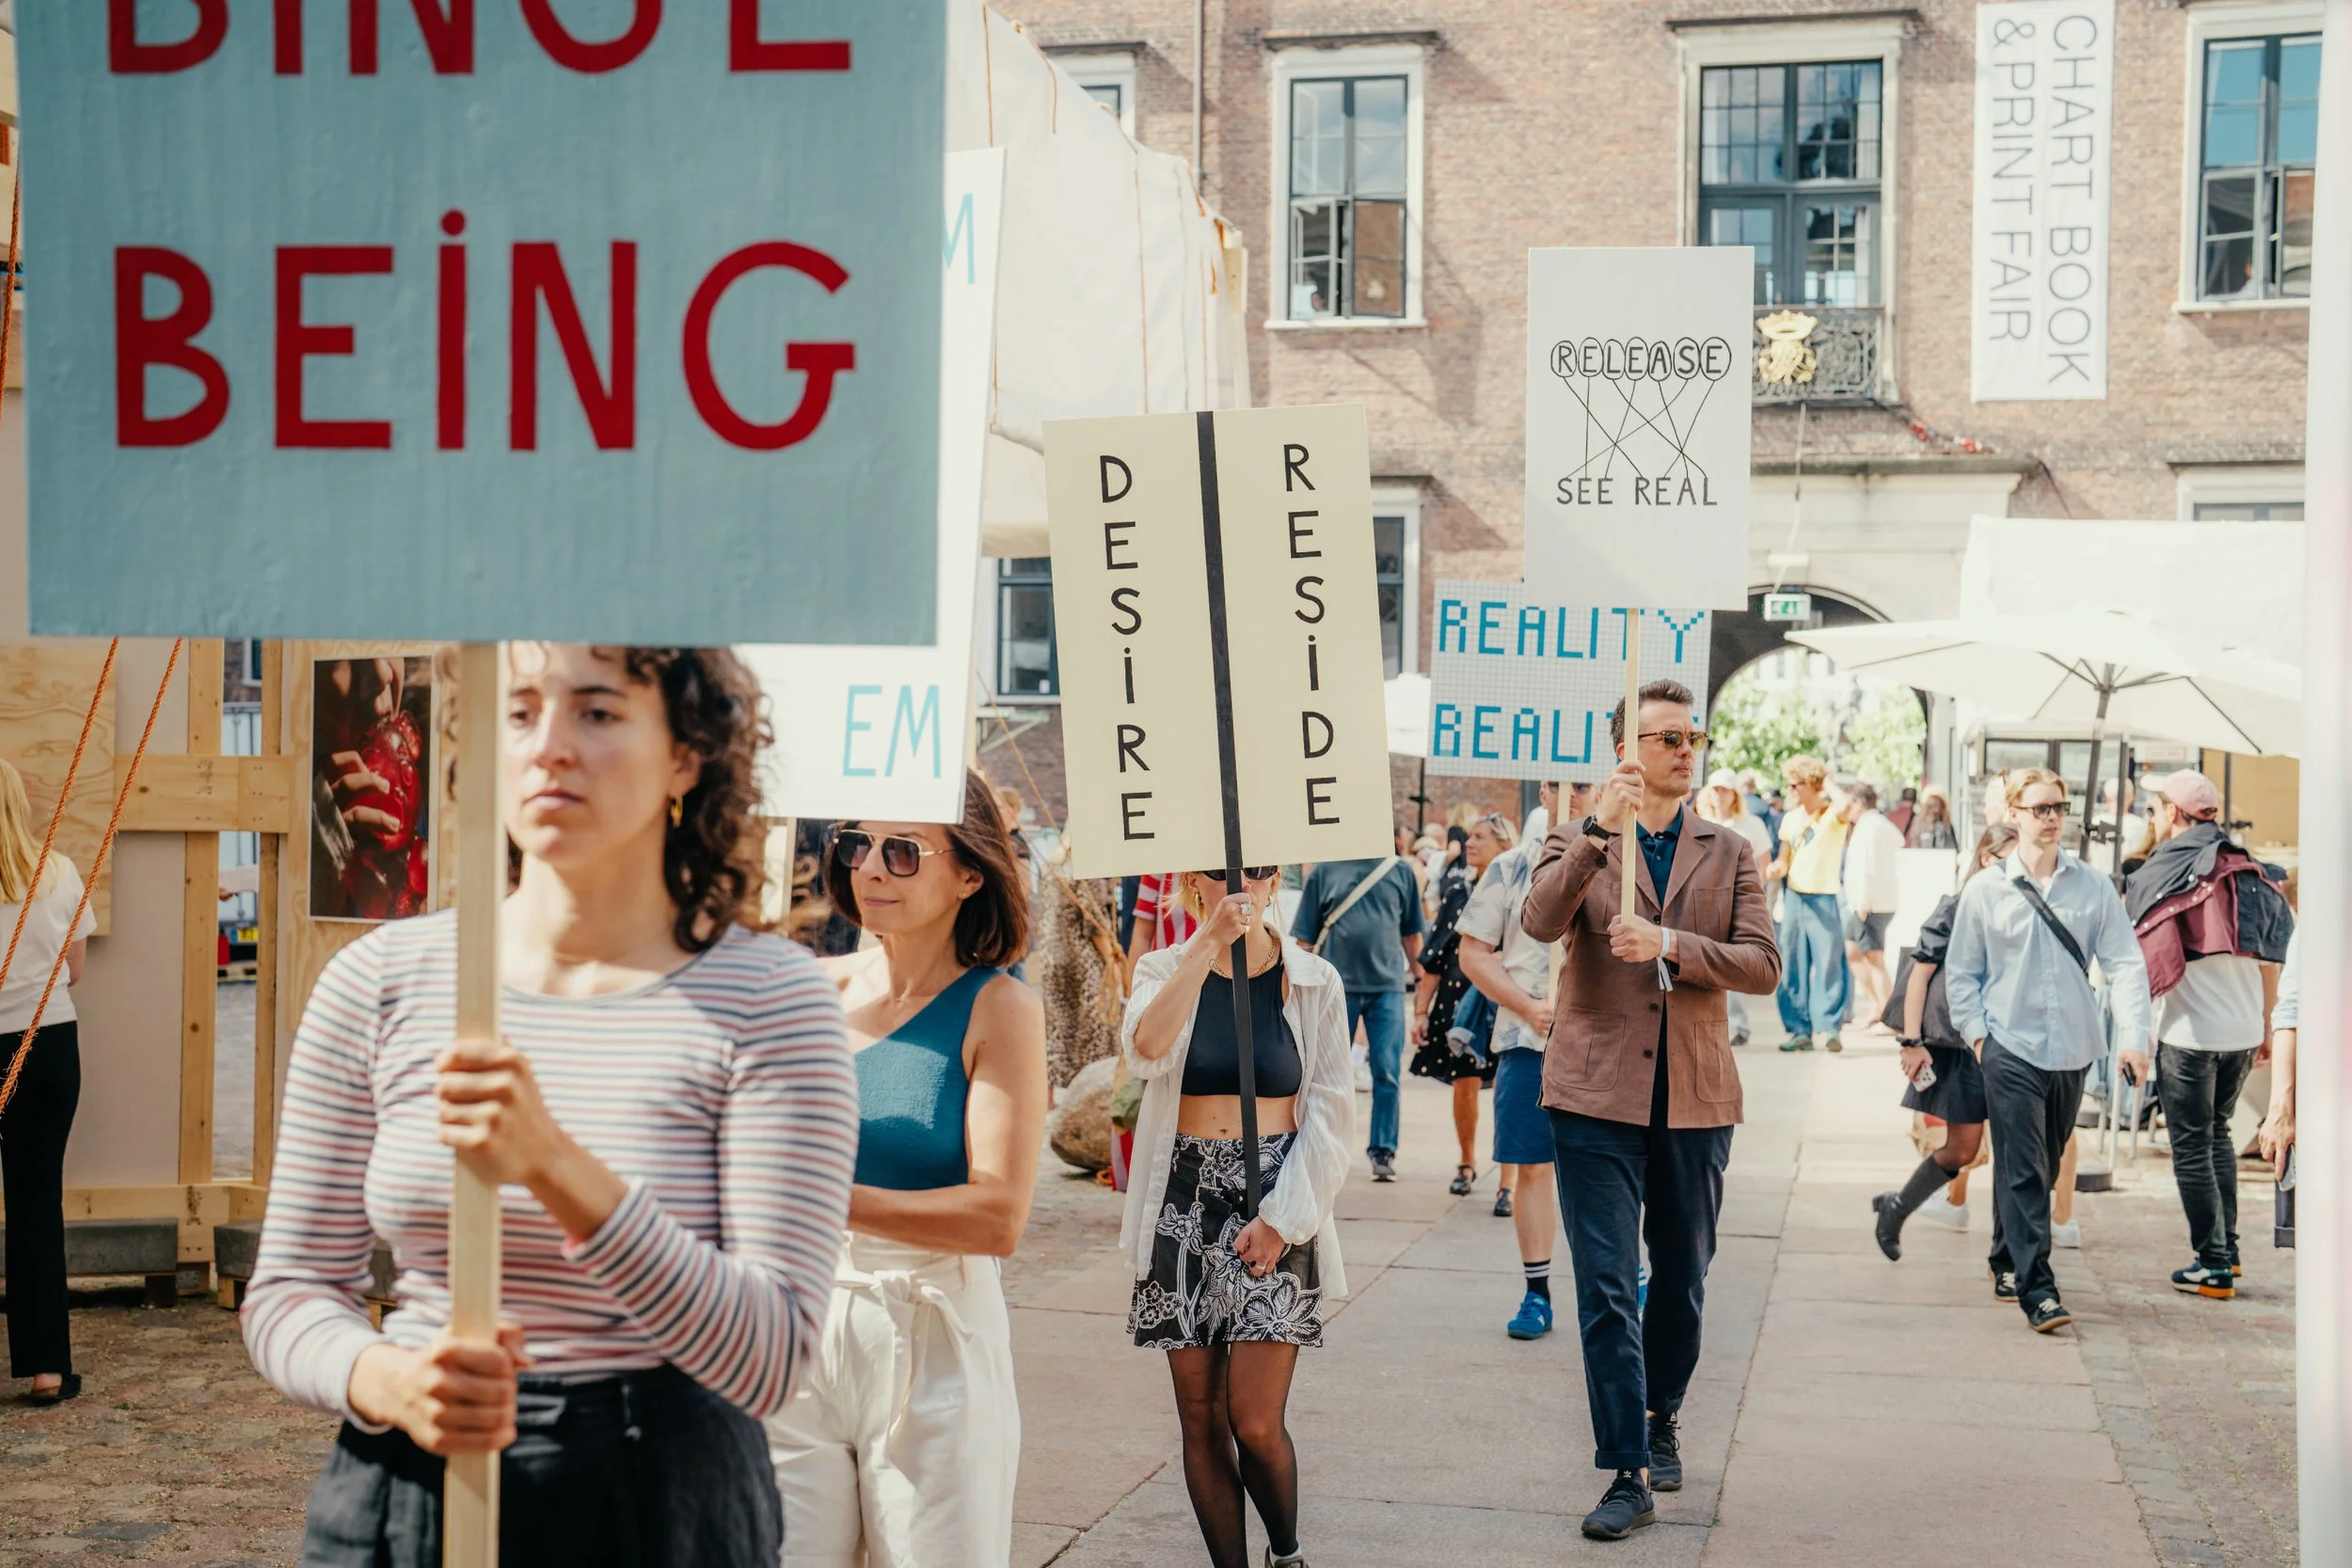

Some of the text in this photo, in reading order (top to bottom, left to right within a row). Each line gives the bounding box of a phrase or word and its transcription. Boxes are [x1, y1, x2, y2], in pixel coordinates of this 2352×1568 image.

[1990, 19, 2036, 340] & PRINT FAIR
[2047, 15, 2097, 384] CHART BOOK
[1558, 345, 1723, 374] RELEASE
[1556, 477, 1718, 506] SEE REAL
